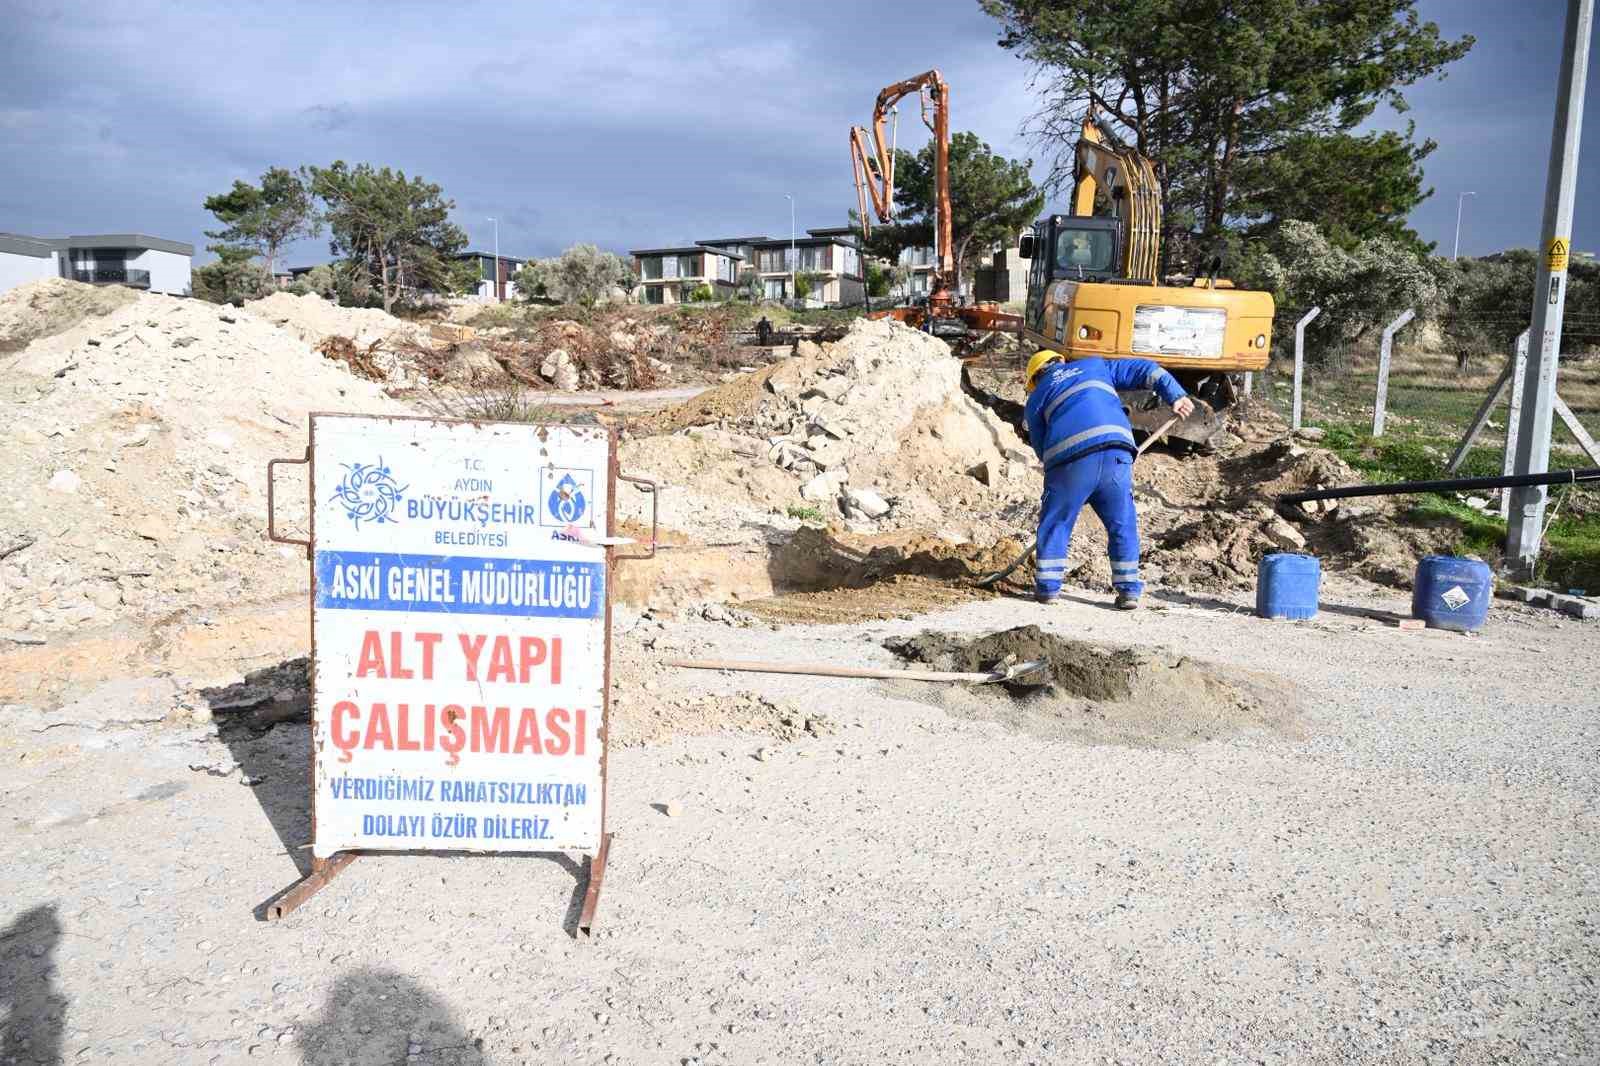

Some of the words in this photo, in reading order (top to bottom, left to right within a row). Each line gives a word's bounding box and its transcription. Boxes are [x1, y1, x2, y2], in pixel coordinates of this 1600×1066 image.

[454, 478, 493, 492] AYDIN
[408, 494, 534, 527] BÜYÜKŞEHİR
[435, 529, 508, 547] BELEDİYESİ
[332, 558, 380, 600] ASKİ
[387, 565, 456, 603] GENEL
[462, 563, 591, 609] MÜDÜRLÜĞÜ
[356, 630, 443, 680] ALT
[457, 633, 563, 685] YAPI
[330, 701, 587, 766] ÇALIŞMASI
[330, 775, 435, 801] VERDİĞİMİZ
[440, 780, 587, 805] RAHATSIZLIKTAN
[363, 814, 425, 837] DOLAYI
[431, 812, 477, 838] ÖZÜR
[483, 814, 554, 840] DİLERİZ.
